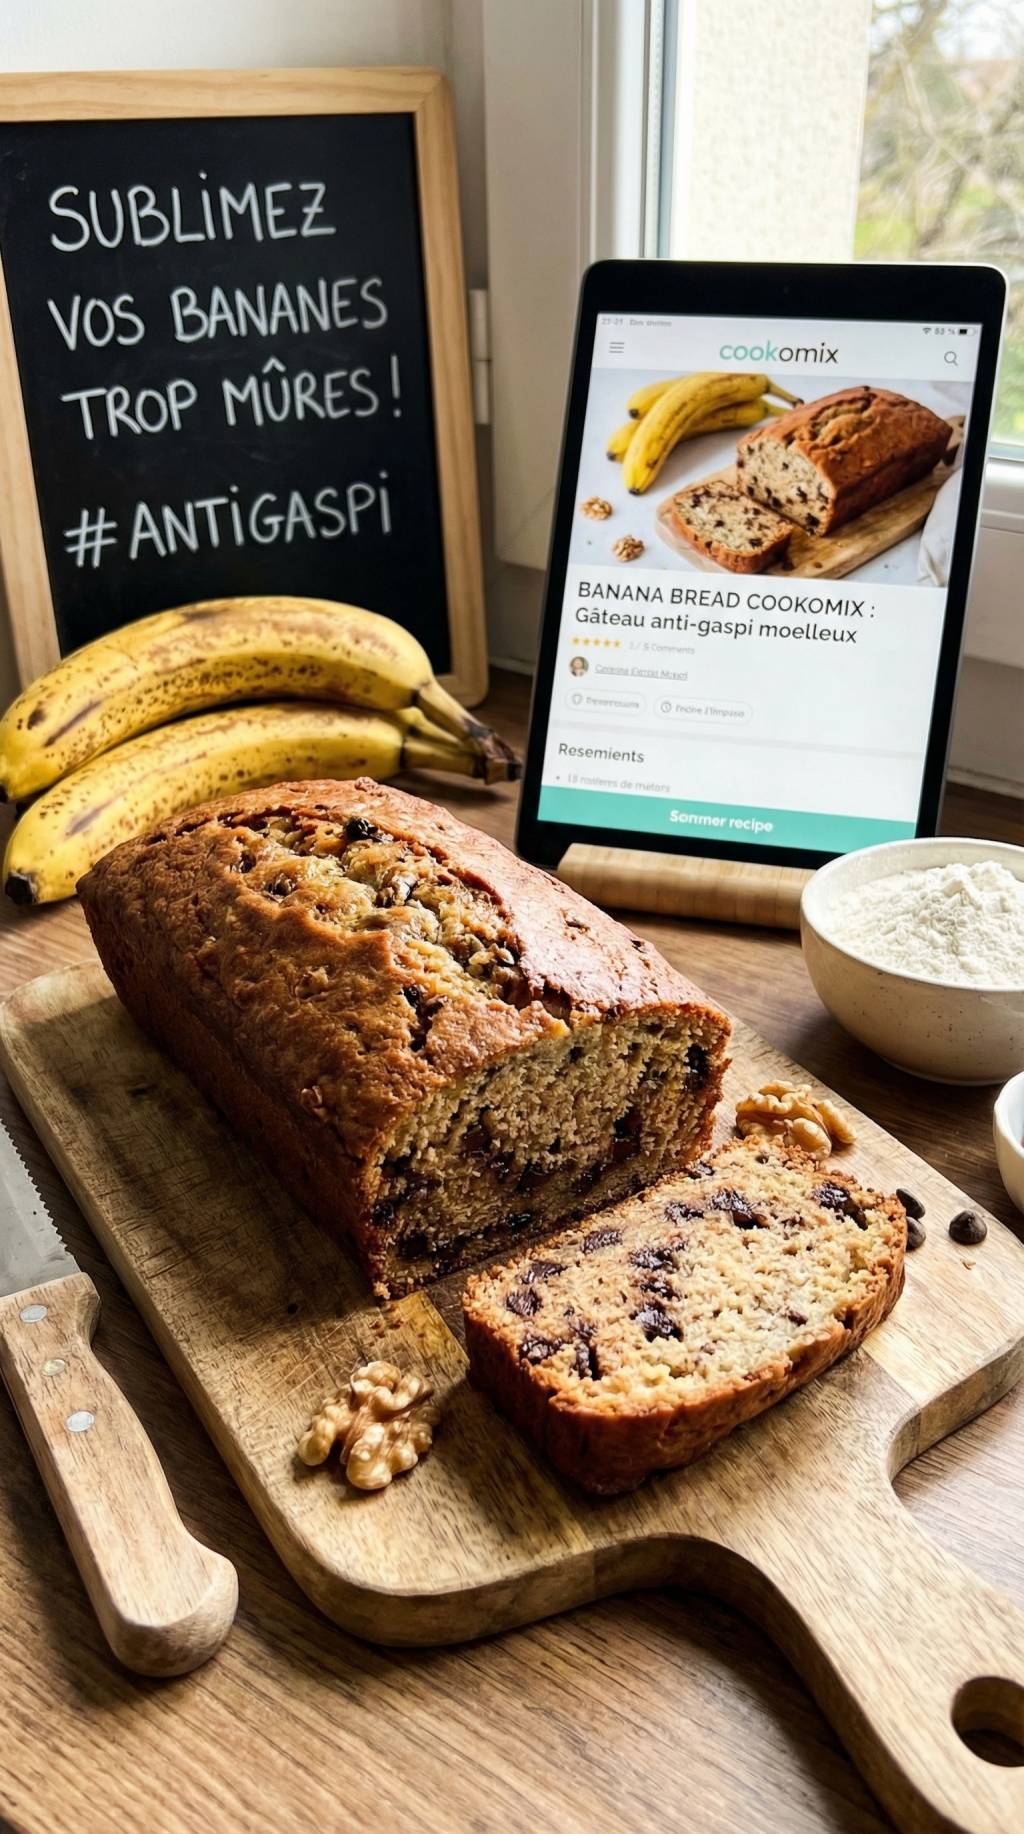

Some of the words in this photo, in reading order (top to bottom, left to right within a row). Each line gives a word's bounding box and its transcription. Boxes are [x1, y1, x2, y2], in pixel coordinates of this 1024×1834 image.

[47, 294, 146, 351] VOS
[170, 277, 389, 343] BANANES
[719, 340, 839, 364] cookomix
[61, 378, 198, 440] TROP
[221, 356, 380, 427] MÛRES
[577, 581, 664, 603] BANANA
[670, 588, 740, 609] BREAD
[746, 593, 866, 618] COOKOMIX
[575, 607, 645, 628] Gâteau
[651, 614, 754, 640] anti-gaspi
[758, 622, 858, 644] moelleux
[729, 818, 774, 835] recipe
